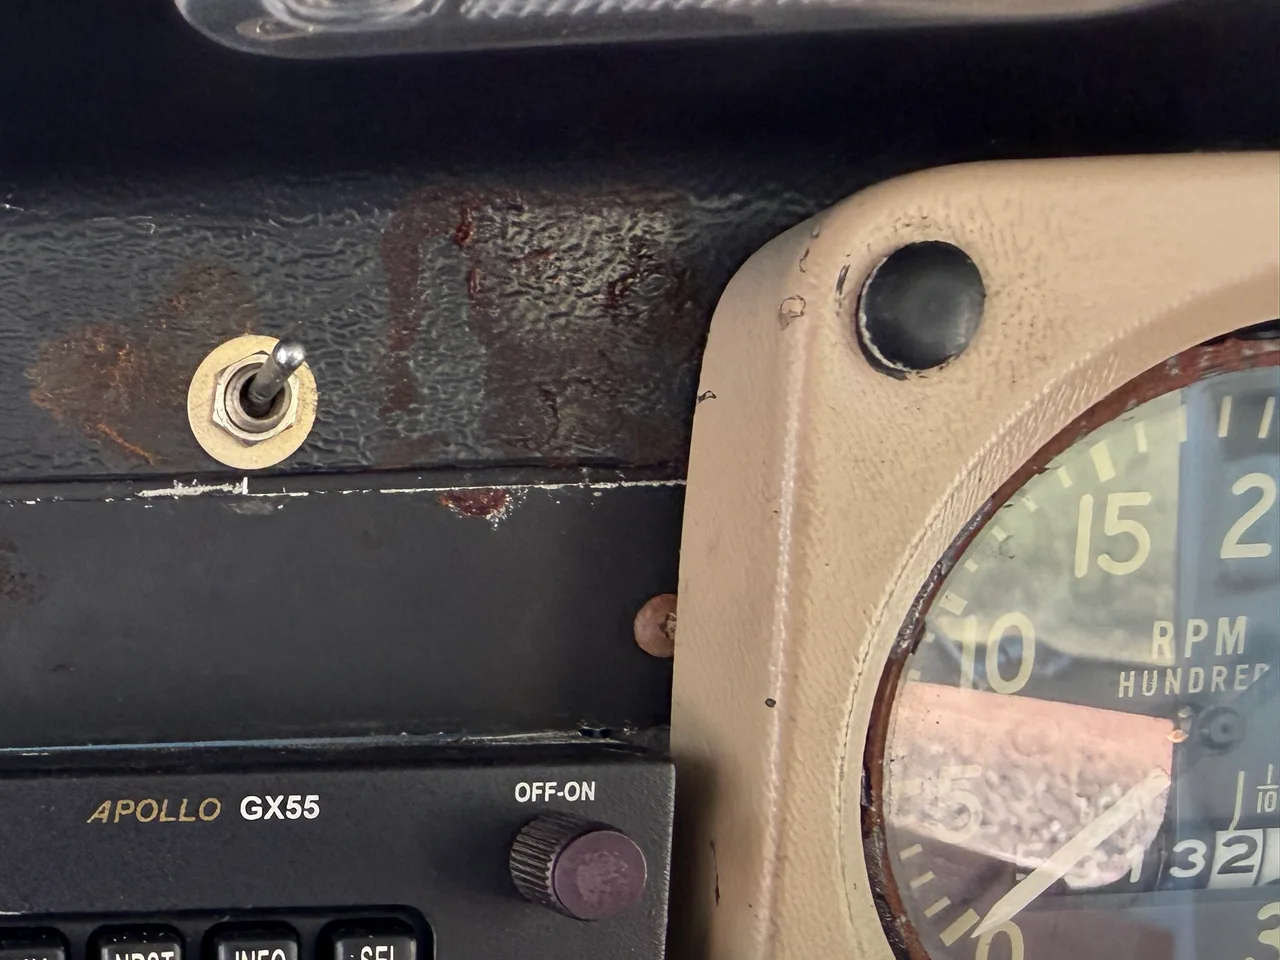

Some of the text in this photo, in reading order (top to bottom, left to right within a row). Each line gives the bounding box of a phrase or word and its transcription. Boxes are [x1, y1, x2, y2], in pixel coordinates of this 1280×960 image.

[1074, 491, 1152, 578] 15
[960, 611, 1036, 694] 10
[1151, 615, 1248, 660] RPM
[86, 794, 320, 825] APOLLO GX55
[514, 781, 596, 803] OFF-ON
